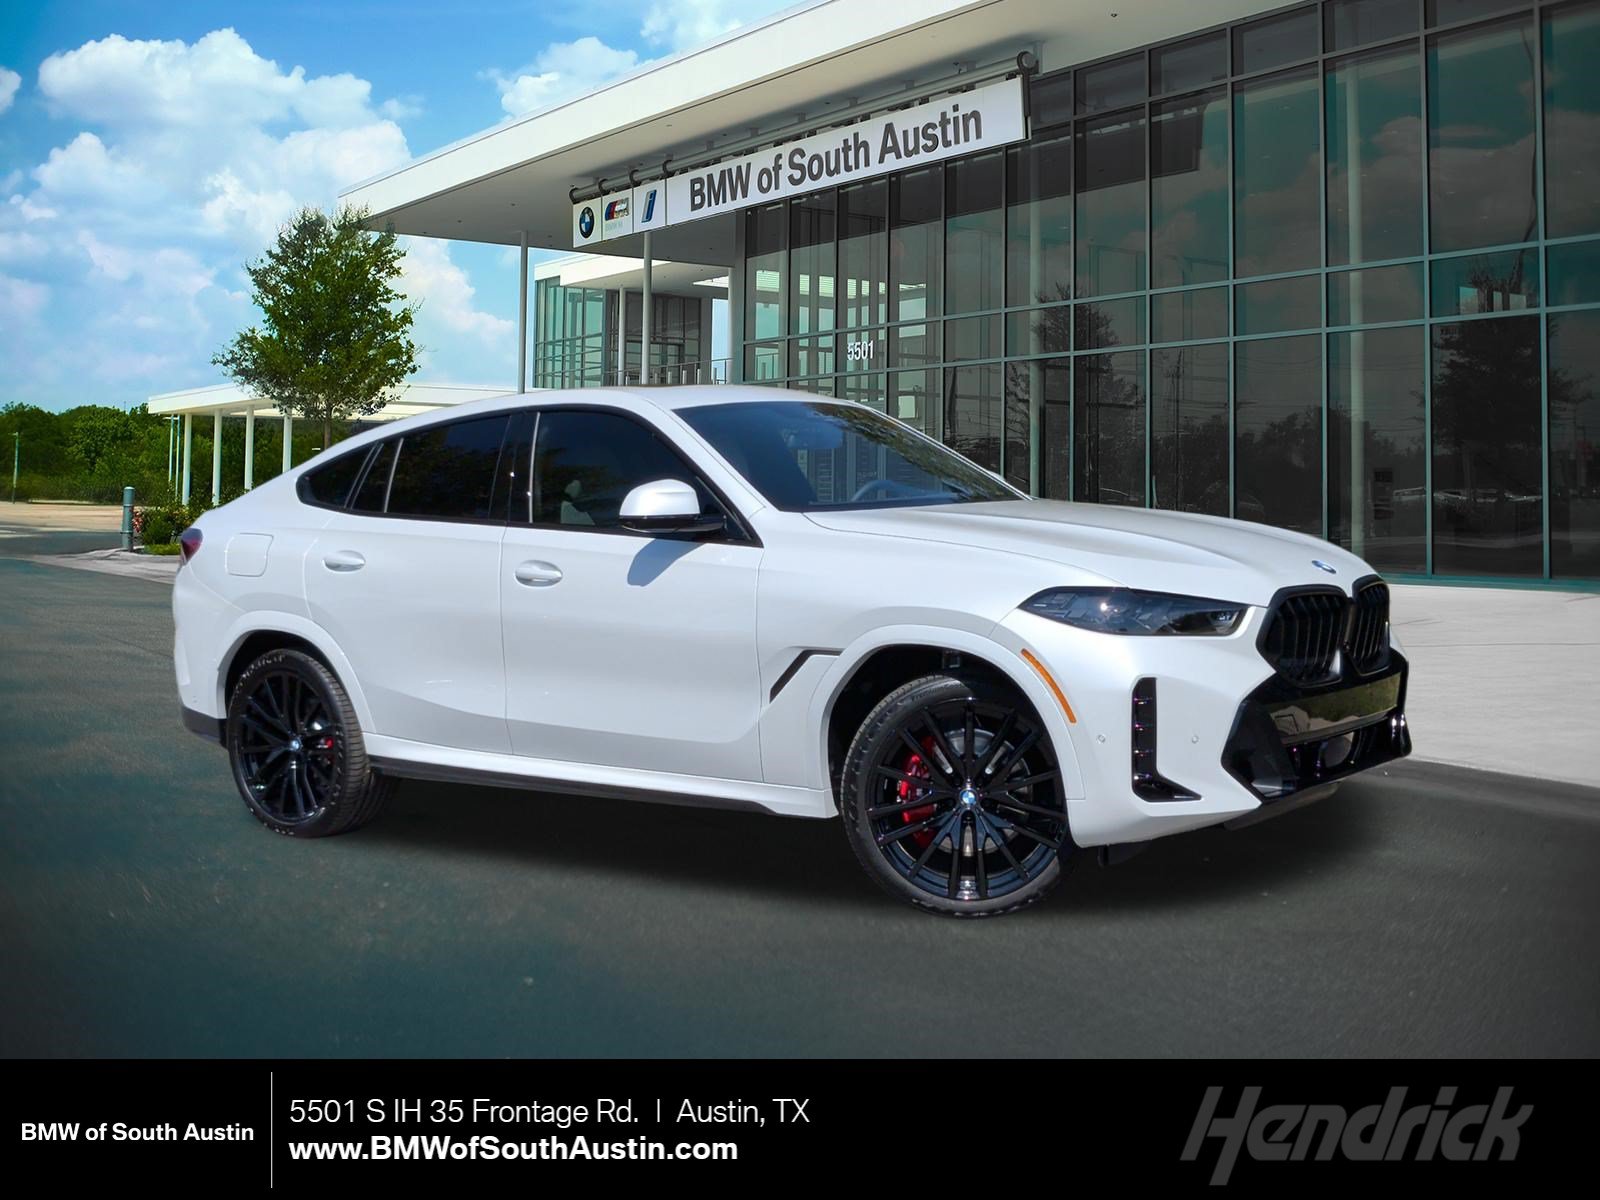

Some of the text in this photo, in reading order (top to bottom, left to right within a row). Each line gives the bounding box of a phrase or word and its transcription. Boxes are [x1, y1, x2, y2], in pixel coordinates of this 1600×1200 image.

[690, 162, 752, 212] BMW
[757, 153, 783, 194] of
[787, 131, 871, 187] South
[878, 103, 983, 165] Austin
[847, 340, 874, 361] 5501
